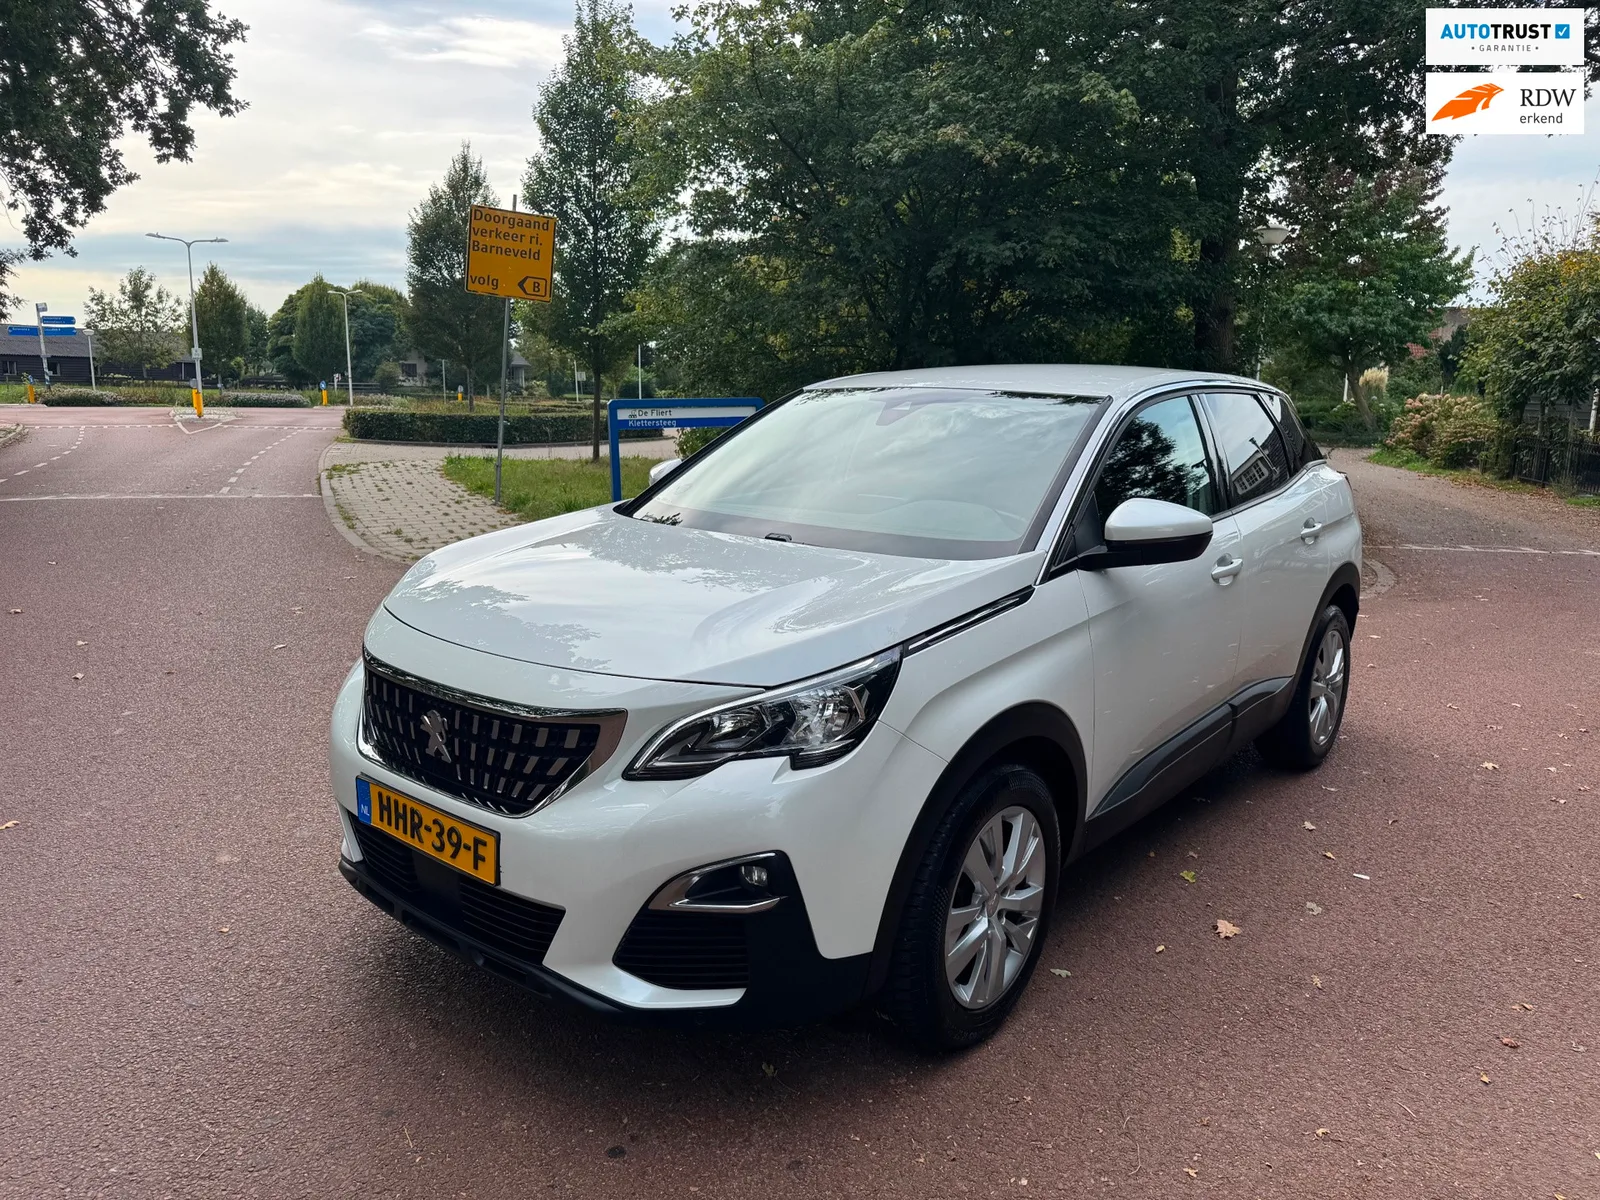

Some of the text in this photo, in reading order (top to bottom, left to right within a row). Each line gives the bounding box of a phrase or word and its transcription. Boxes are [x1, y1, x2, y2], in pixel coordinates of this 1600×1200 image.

[473, 209, 550, 232] Doorgaand
[472, 227, 543, 246] verkeer ri.
[472, 240, 541, 261] Barneveld
[470, 274, 541, 293] volg B
[638, 409, 672, 417] De Fliert
[628, 419, 677, 428] Klettersteeg
[360, 803, 370, 816] NL
[377, 791, 488, 871] HHR-39-F
